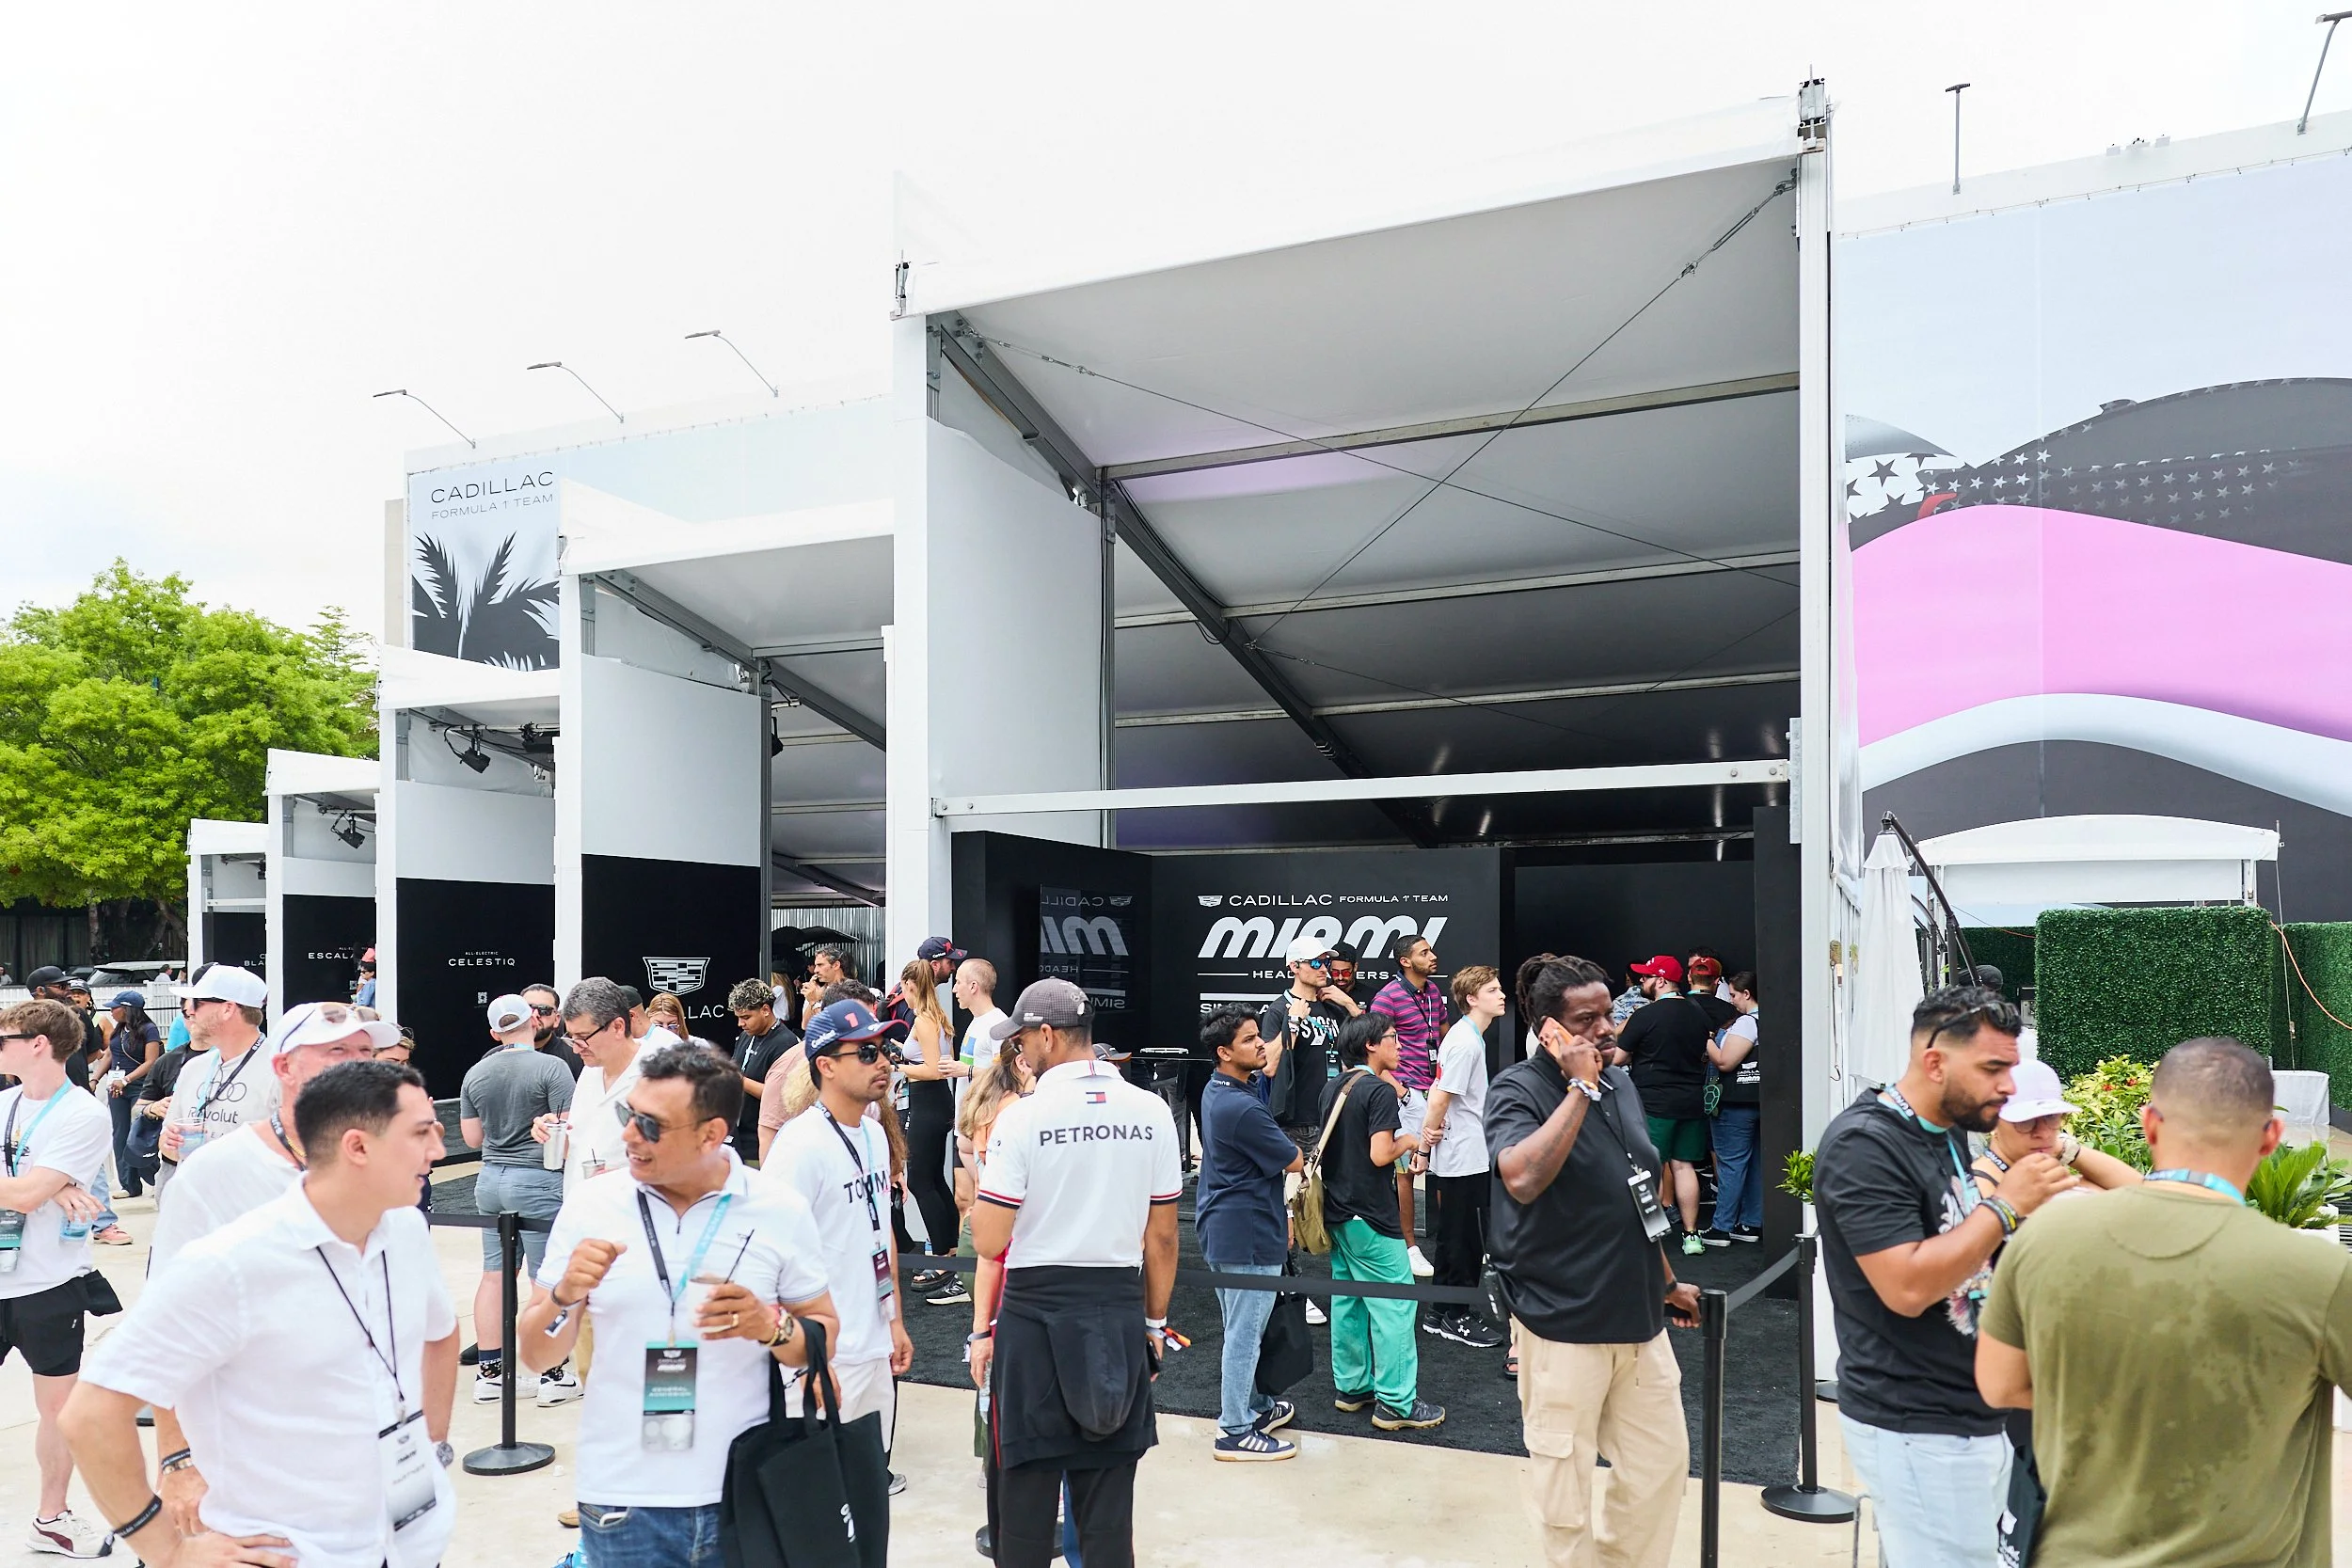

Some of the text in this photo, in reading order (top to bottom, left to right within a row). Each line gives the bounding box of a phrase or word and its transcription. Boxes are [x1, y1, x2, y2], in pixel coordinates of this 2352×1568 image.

[431, 471, 553, 503] CADILLAC
[431, 502, 498, 519] FORMULA
[514, 494, 553, 507] TEAM
[1229, 894, 1333, 907] CADILLAC
[448, 958, 516, 967] CELESTIQ
[844, 1012, 859, 1028] 1
[1040, 1125, 1153, 1147] PETRONAS
